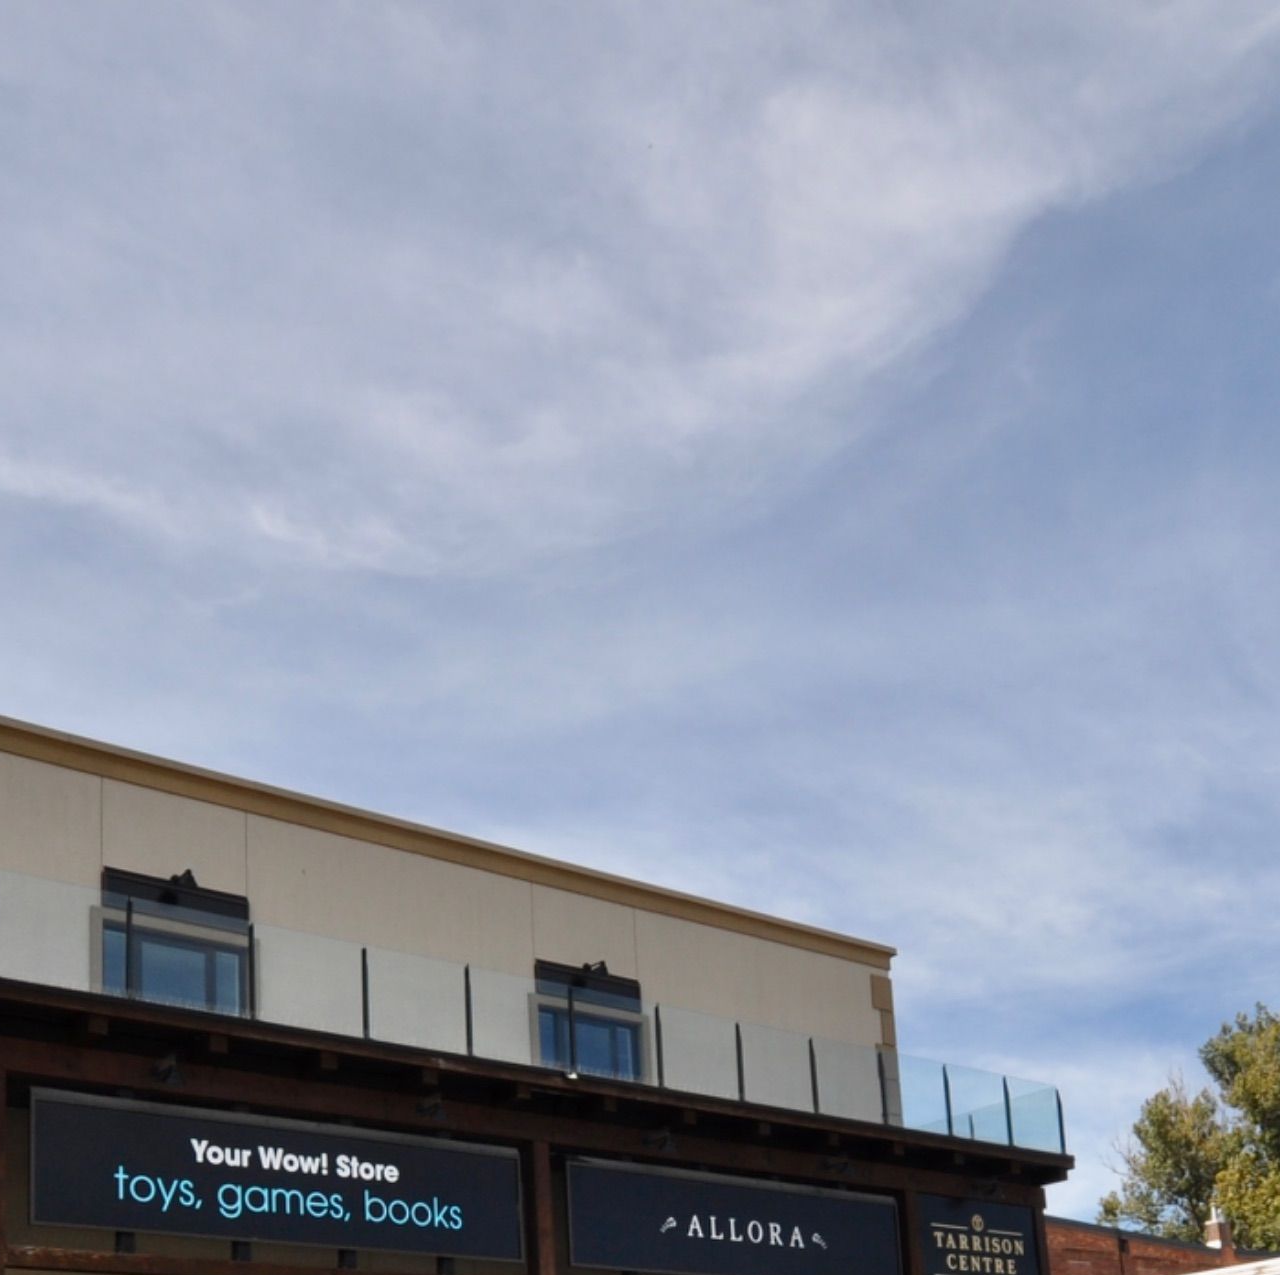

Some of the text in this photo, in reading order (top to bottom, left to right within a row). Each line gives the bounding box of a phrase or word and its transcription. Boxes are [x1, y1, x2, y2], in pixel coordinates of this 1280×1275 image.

[190, 1138, 400, 1184] Your Wow! Store
[113, 1165, 463, 1230] toys, games, books
[687, 1214, 806, 1249] ALLORA
[933, 1231, 1024, 1256] TARRISON
[946, 1253, 1017, 1275] CENTRE
